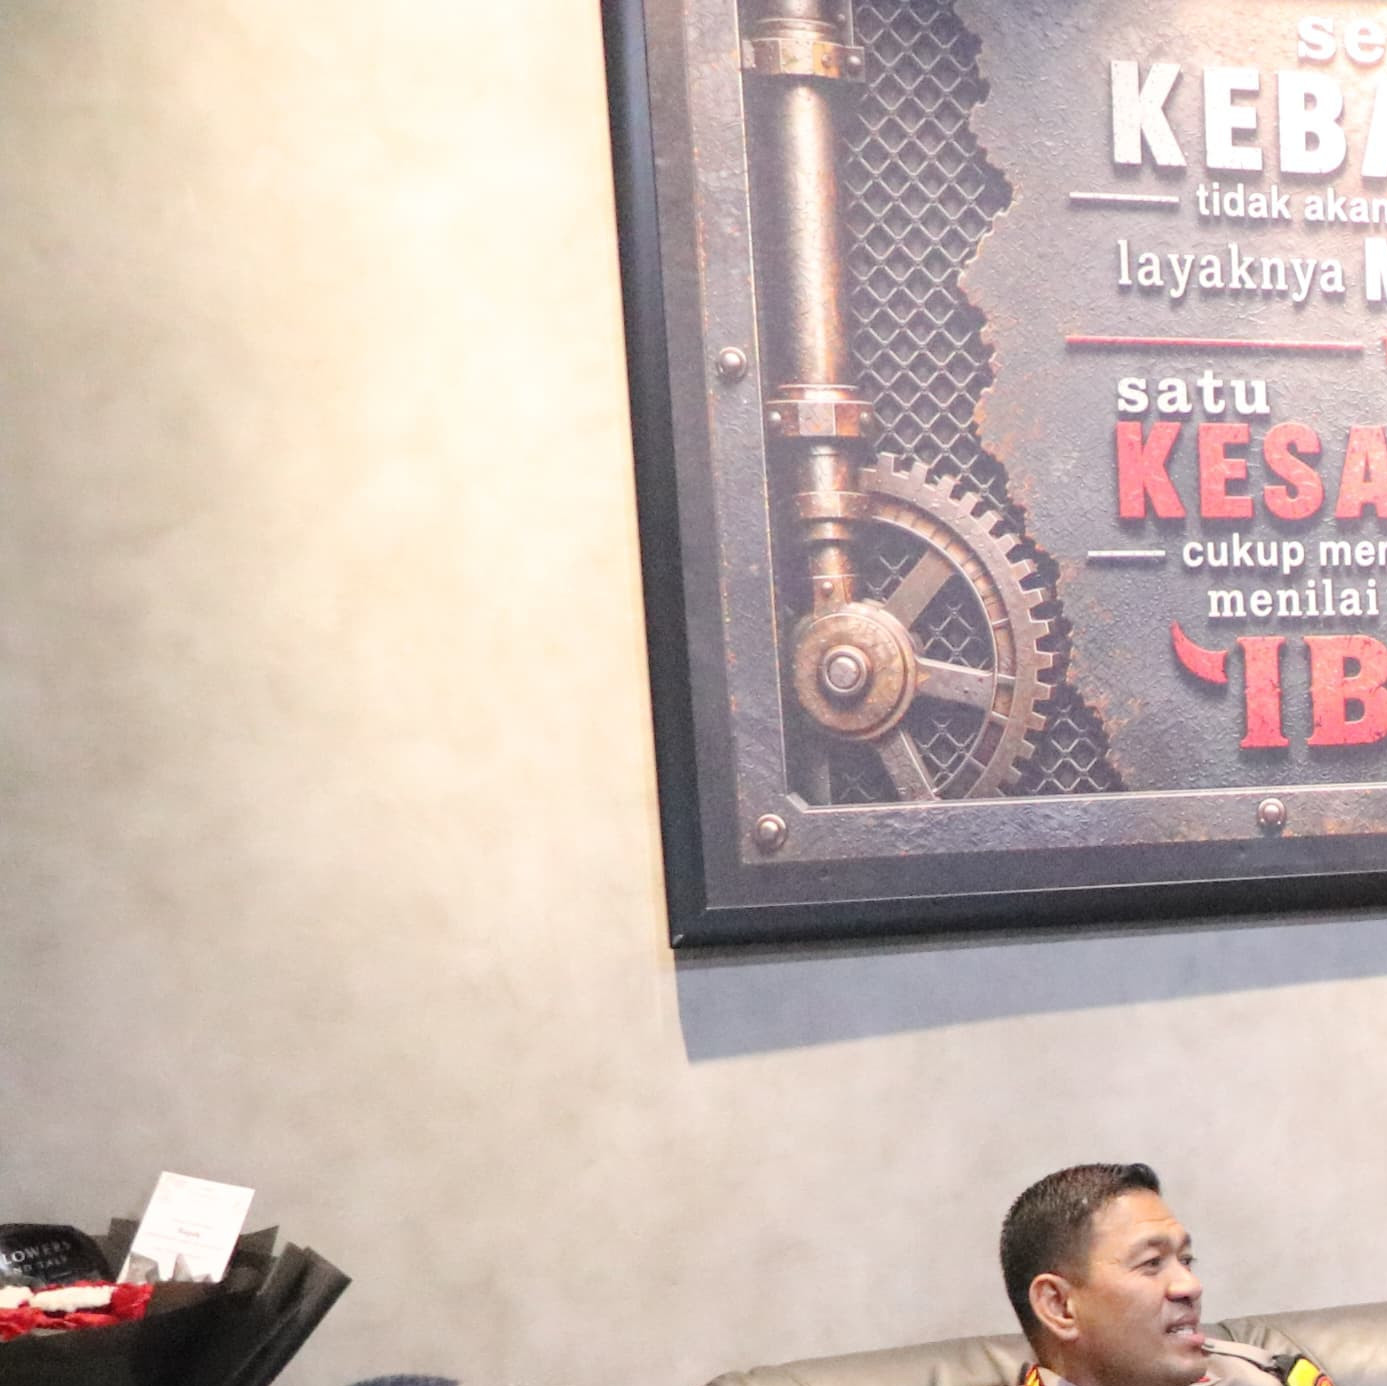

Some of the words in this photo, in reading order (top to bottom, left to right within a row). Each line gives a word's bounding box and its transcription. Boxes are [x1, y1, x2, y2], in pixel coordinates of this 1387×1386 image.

[1195, 184, 1291, 221] tidak
[1117, 240, 1346, 303] layaknya
[1116, 371, 1271, 414] satu
[1182, 534, 1306, 569] cukup
